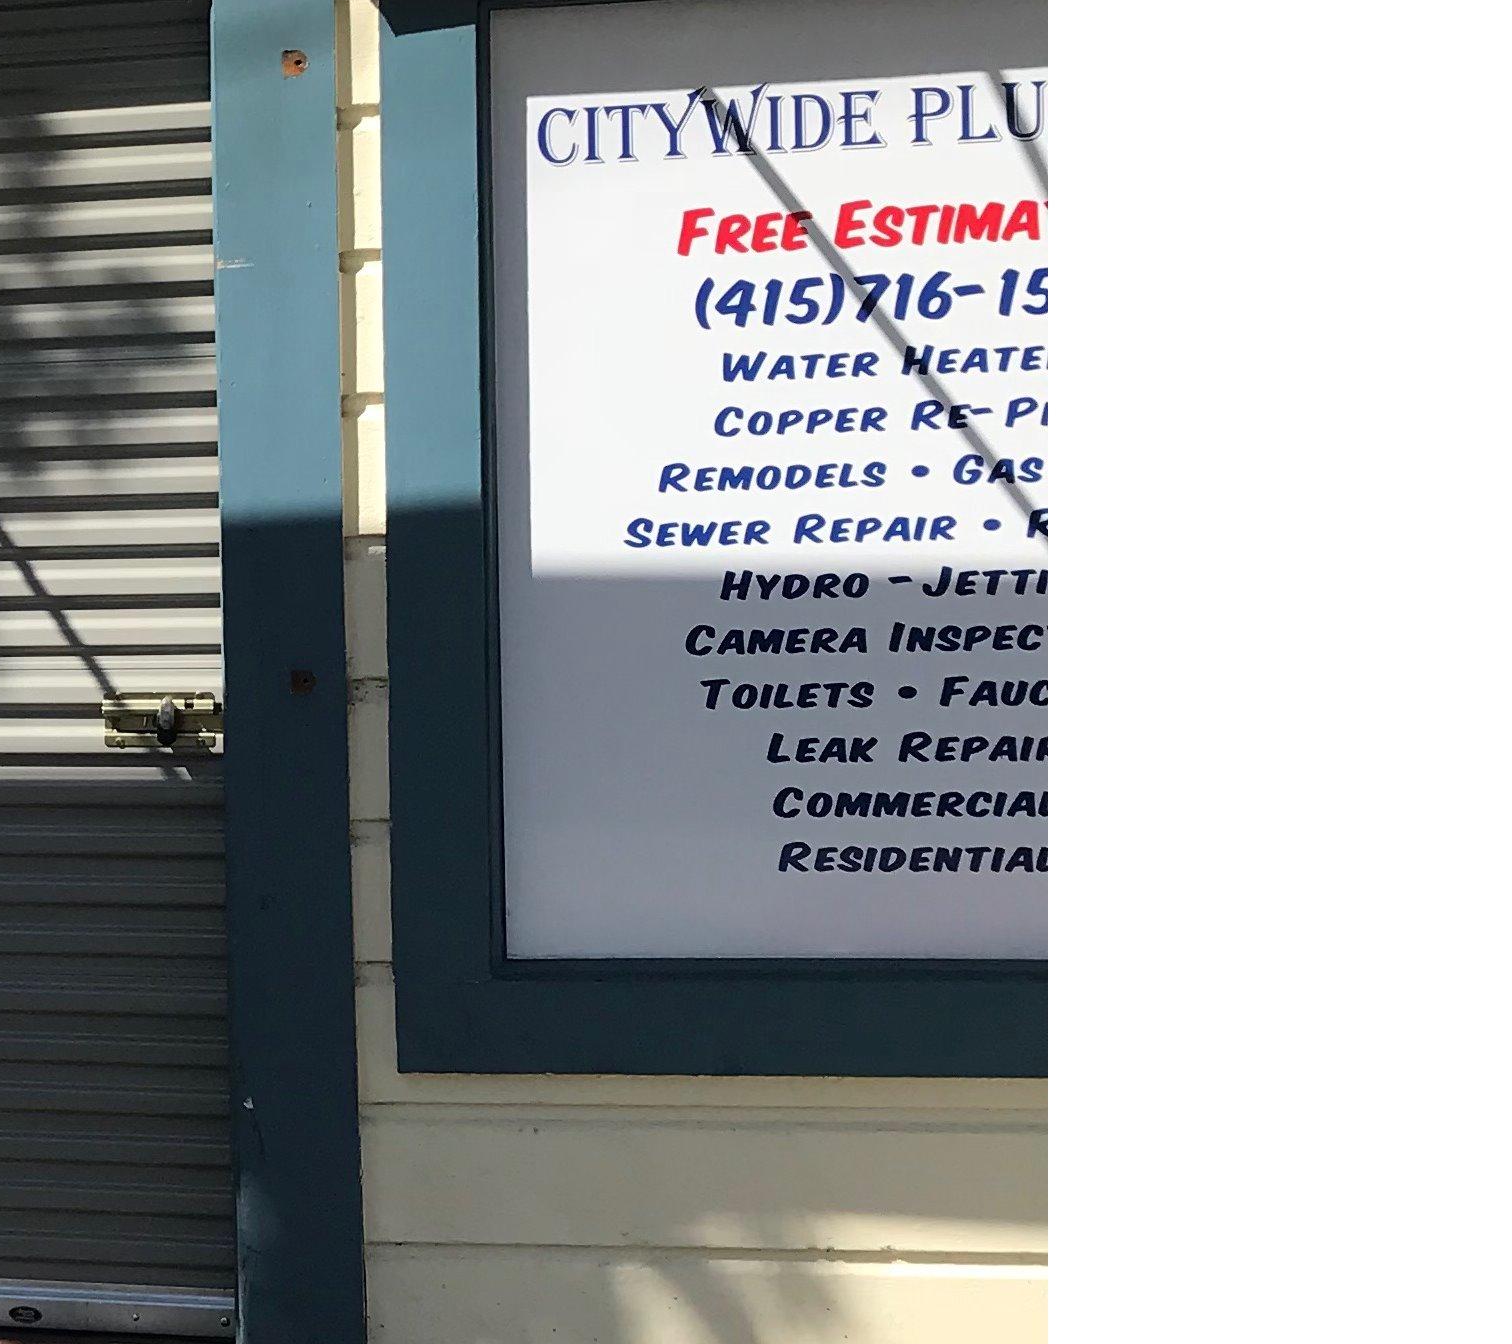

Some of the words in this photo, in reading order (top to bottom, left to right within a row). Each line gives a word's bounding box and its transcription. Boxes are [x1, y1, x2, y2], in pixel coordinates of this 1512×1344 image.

[537, 82, 886, 167] CITYWIDE
[907, 80, 1048, 147] PLU
[677, 207, 813, 257] FREE
[834, 199, 1048, 249] ESTIMA
[722, 351, 880, 383] WATER
[901, 344, 1048, 376] HEATE
[714, 406, 888, 438] COPPER
[658, 461, 887, 493] REMODELS
[953, 454, 1044, 485] GAS
[623, 517, 771, 548] SEWER
[793, 513, 957, 544] REPAIR
[719, 570, 870, 601] HYDRO
[685, 624, 868, 657] CAMERA
[888, 621, 1048, 653] INSPEC
[699, 678, 875, 710] TOILETS
[766, 732, 879, 764] LEAK
